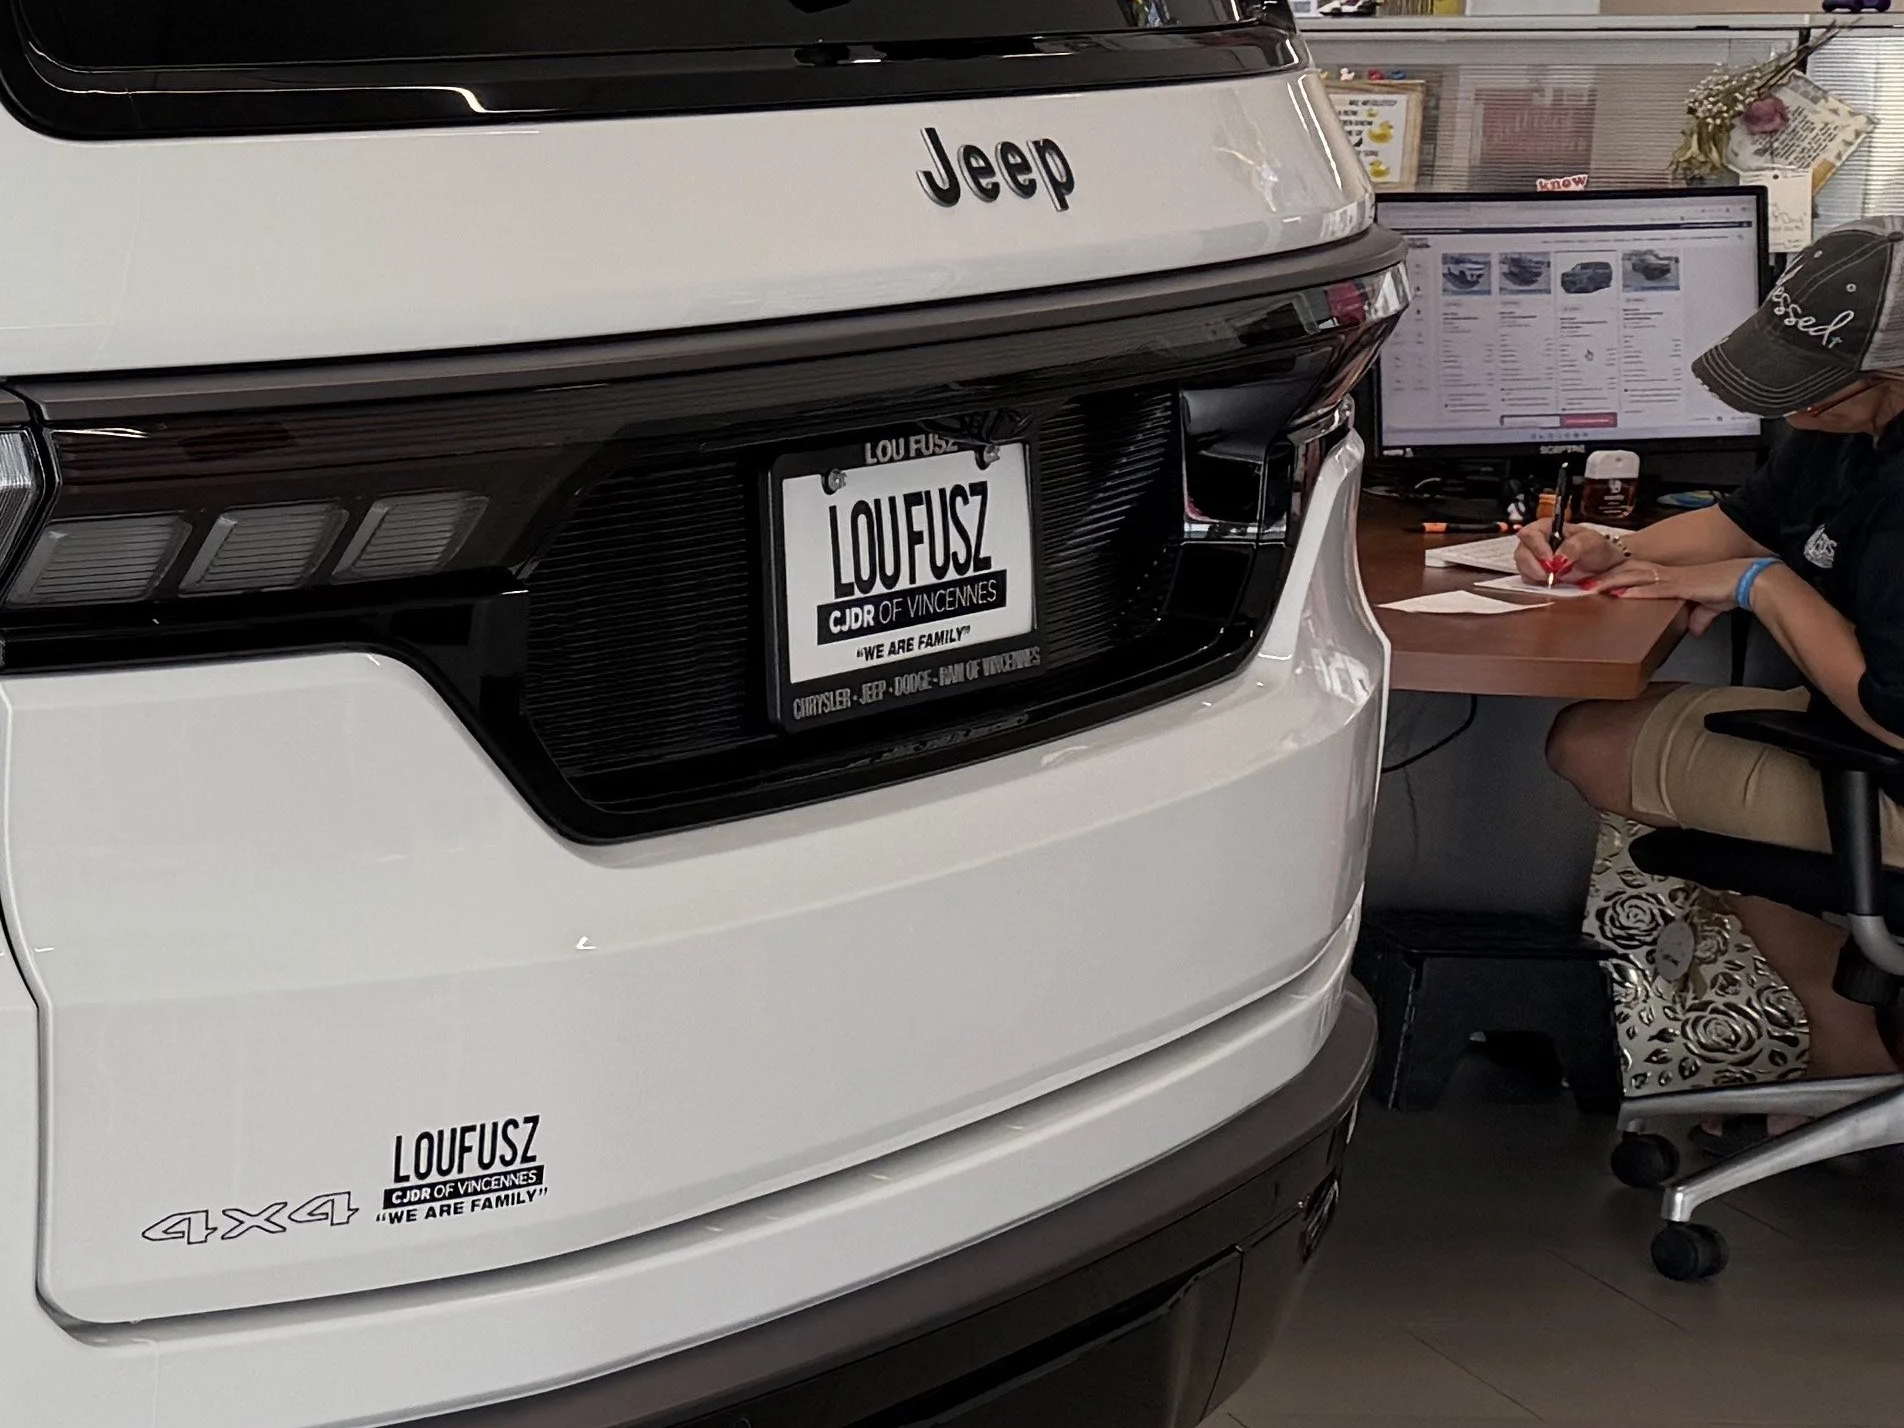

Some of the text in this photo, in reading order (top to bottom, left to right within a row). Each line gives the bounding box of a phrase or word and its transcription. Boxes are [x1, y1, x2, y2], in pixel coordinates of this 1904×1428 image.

[916, 127, 1075, 212] Jeep
[1538, 176, 1588, 191] know
[865, 433, 959, 465] LOU FUSZ
[829, 579, 997, 634] CJDR OF VINCENNES
[888, 637, 915, 657] ARE
[793, 688, 852, 720] CHRYSLER
[859, 680, 887, 705] JEEP
[894, 670, 934, 697] DODGE
[966, 658, 982, 681] OF
[391, 1169, 538, 1205] CJDR OF VINCENNES
[424, 1200, 466, 1220] ARE
